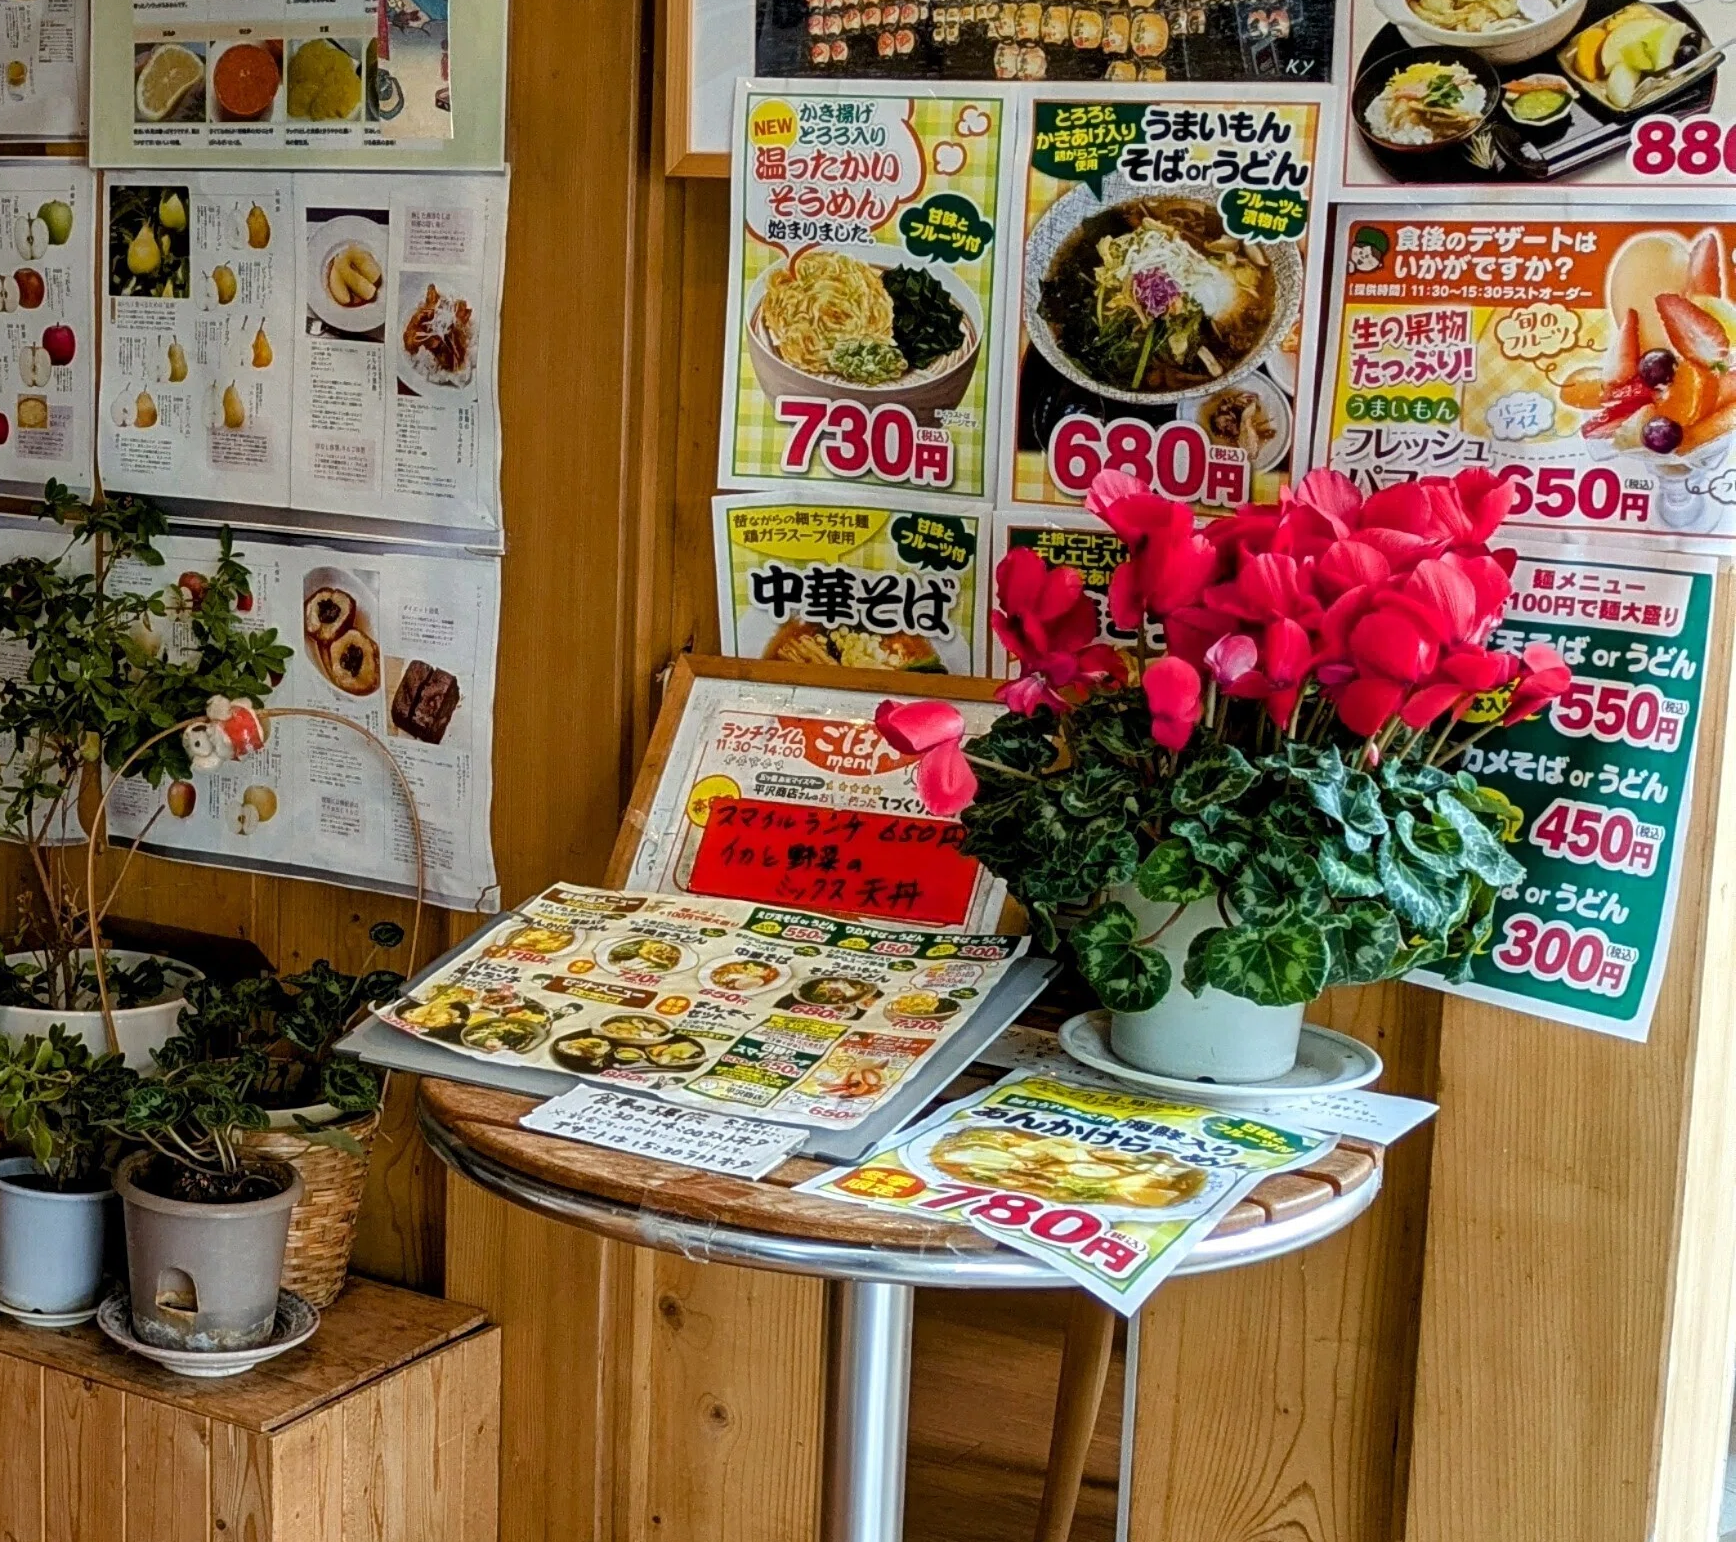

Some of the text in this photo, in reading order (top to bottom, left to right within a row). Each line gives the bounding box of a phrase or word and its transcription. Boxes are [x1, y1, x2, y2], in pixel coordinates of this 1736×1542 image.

[754, 117, 793, 136] NEW
[799, 103, 874, 124] かき揚げ
[1145, 109, 1292, 145] うまいもん
[798, 125, 886, 147] とろろ入り
[1036, 120, 1136, 151] かきあげ入り
[755, 147, 899, 183] 温ったかい
[1075, 158, 1099, 173] 使用
[768, 185, 886, 220] そうめん
[1236, 190, 1303, 219] フルーツと
[767, 220, 875, 245] 始まりました。
[927, 207, 969, 232] 甘味と
[909, 222, 983, 254] フルーツ付
[1395, 226, 1597, 254] 食後のデザートは
[1395, 255, 1573, 282] いかがですか?
[1352, 310, 1469, 351] 生の果物
[1516, 311, 1558, 330] 旬の
[1505, 327, 1570, 352] フルーツ
[1352, 348, 1476, 387] たっぷり!
[1348, 399, 1458, 421] うまいもん
[1503, 414, 1540, 429] アイス
[780, 400, 950, 482] 730円
[1344, 429, 1489, 462] フレッシュ
[916, 516, 955, 542] 甘味と
[900, 529, 967, 563] フルーツ付
[1533, 568, 1646, 595] 麺メニュー
[751, 564, 956, 637] 中華そば
[1592, 643, 1696, 680] or うどん
[1556, 681, 1680, 745] 550円
[721, 721, 804, 745] ランチタイム
[826, 755, 878, 775] menu
[1569, 764, 1669, 803] or うどん
[1535, 805, 1654, 871] 450円
[1524, 884, 1630, 924] or うどん
[1499, 918, 1626, 990] 300円
[1119, 1117, 1240, 1157] 海鮮入り
[917, 1183, 1139, 1273] 780円
